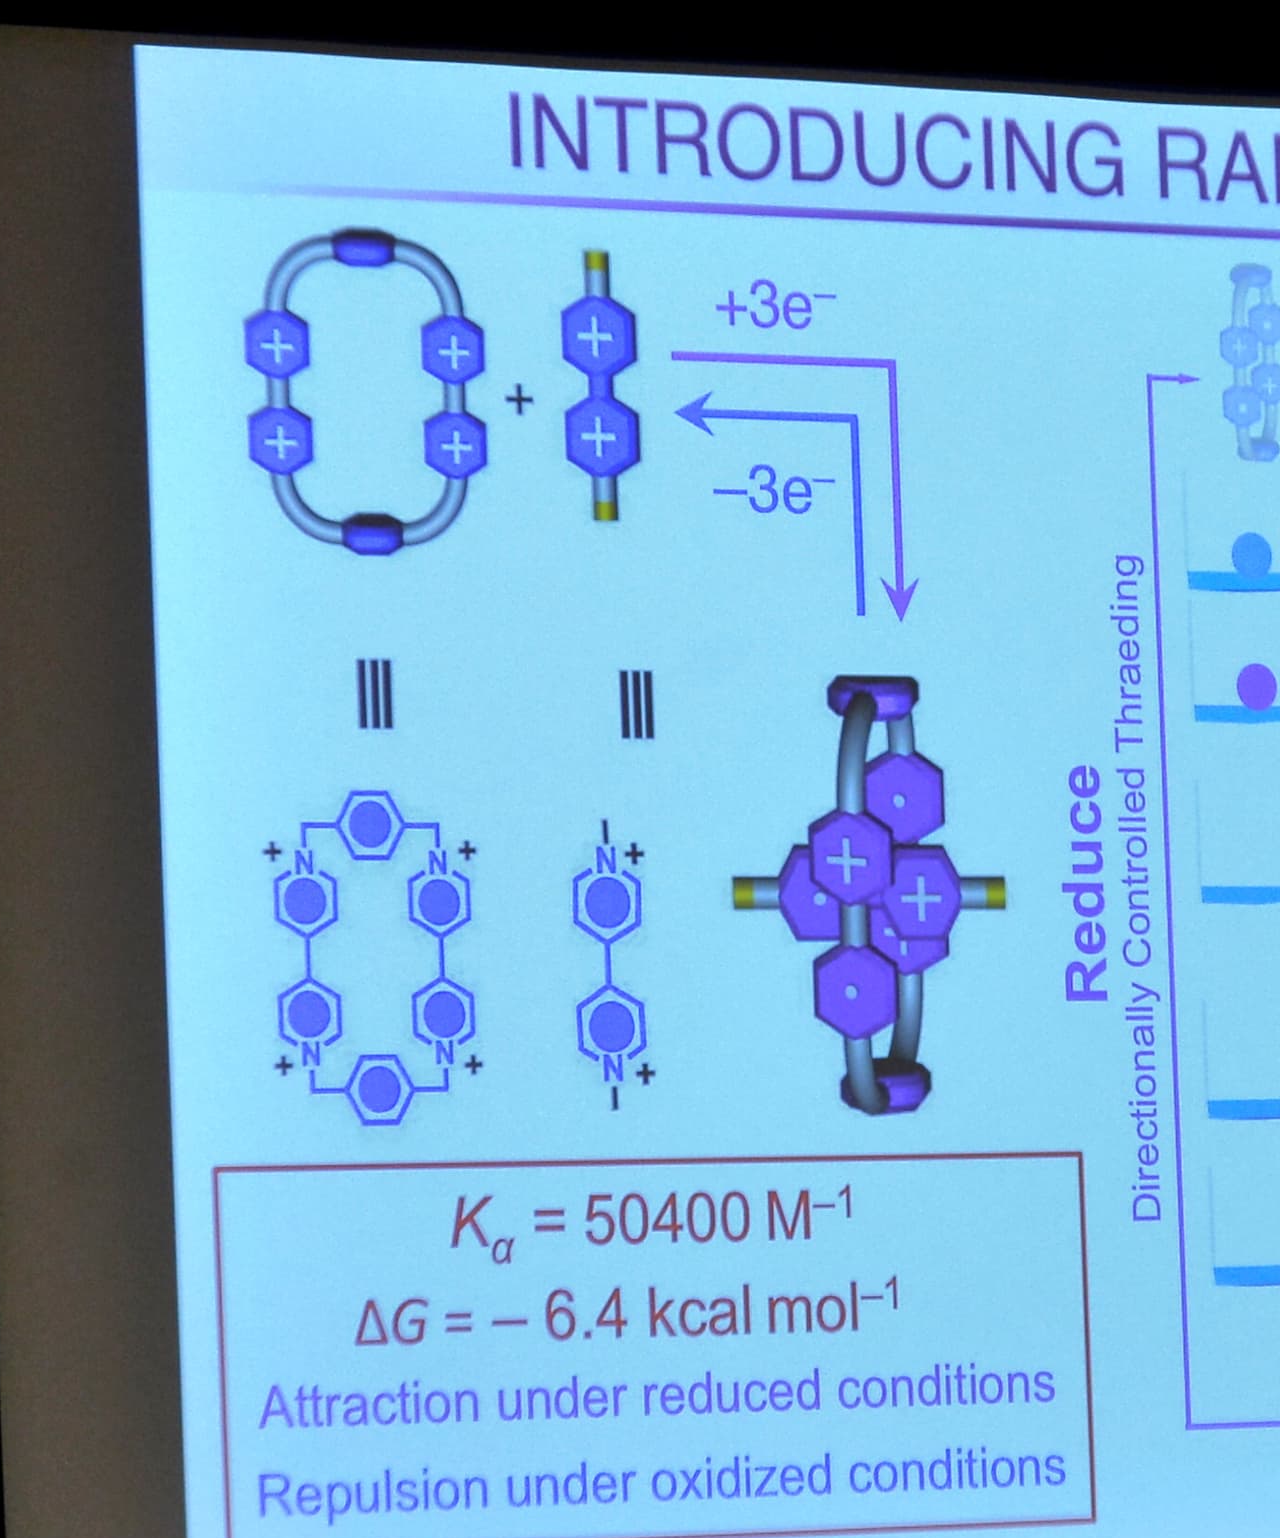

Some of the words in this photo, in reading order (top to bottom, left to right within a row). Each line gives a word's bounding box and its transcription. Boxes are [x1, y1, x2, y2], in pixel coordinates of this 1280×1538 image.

[507, 92, 1124, 198] INTRODUCING
[1109, 554, 1145, 754] Thraeding
[1061, 764, 1109, 1002] Reduce
[1115, 767, 1152, 968] Controlled
[1124, 981, 1162, 1222] Directionally
[585, 1190, 751, 1246] 50400
[545, 1287, 628, 1342] 6.4
[648, 1283, 752, 1338] kcal
[258, 1379, 480, 1430] Attraction
[497, 1375, 628, 1422] under
[643, 1367, 821, 1417] reduced
[838, 1362, 1056, 1410] conditions
[258, 1467, 489, 1526] Repulsion
[506, 1460, 637, 1508] under
[651, 1452, 832, 1502] oxidized
[849, 1445, 1067, 1494] conditions
